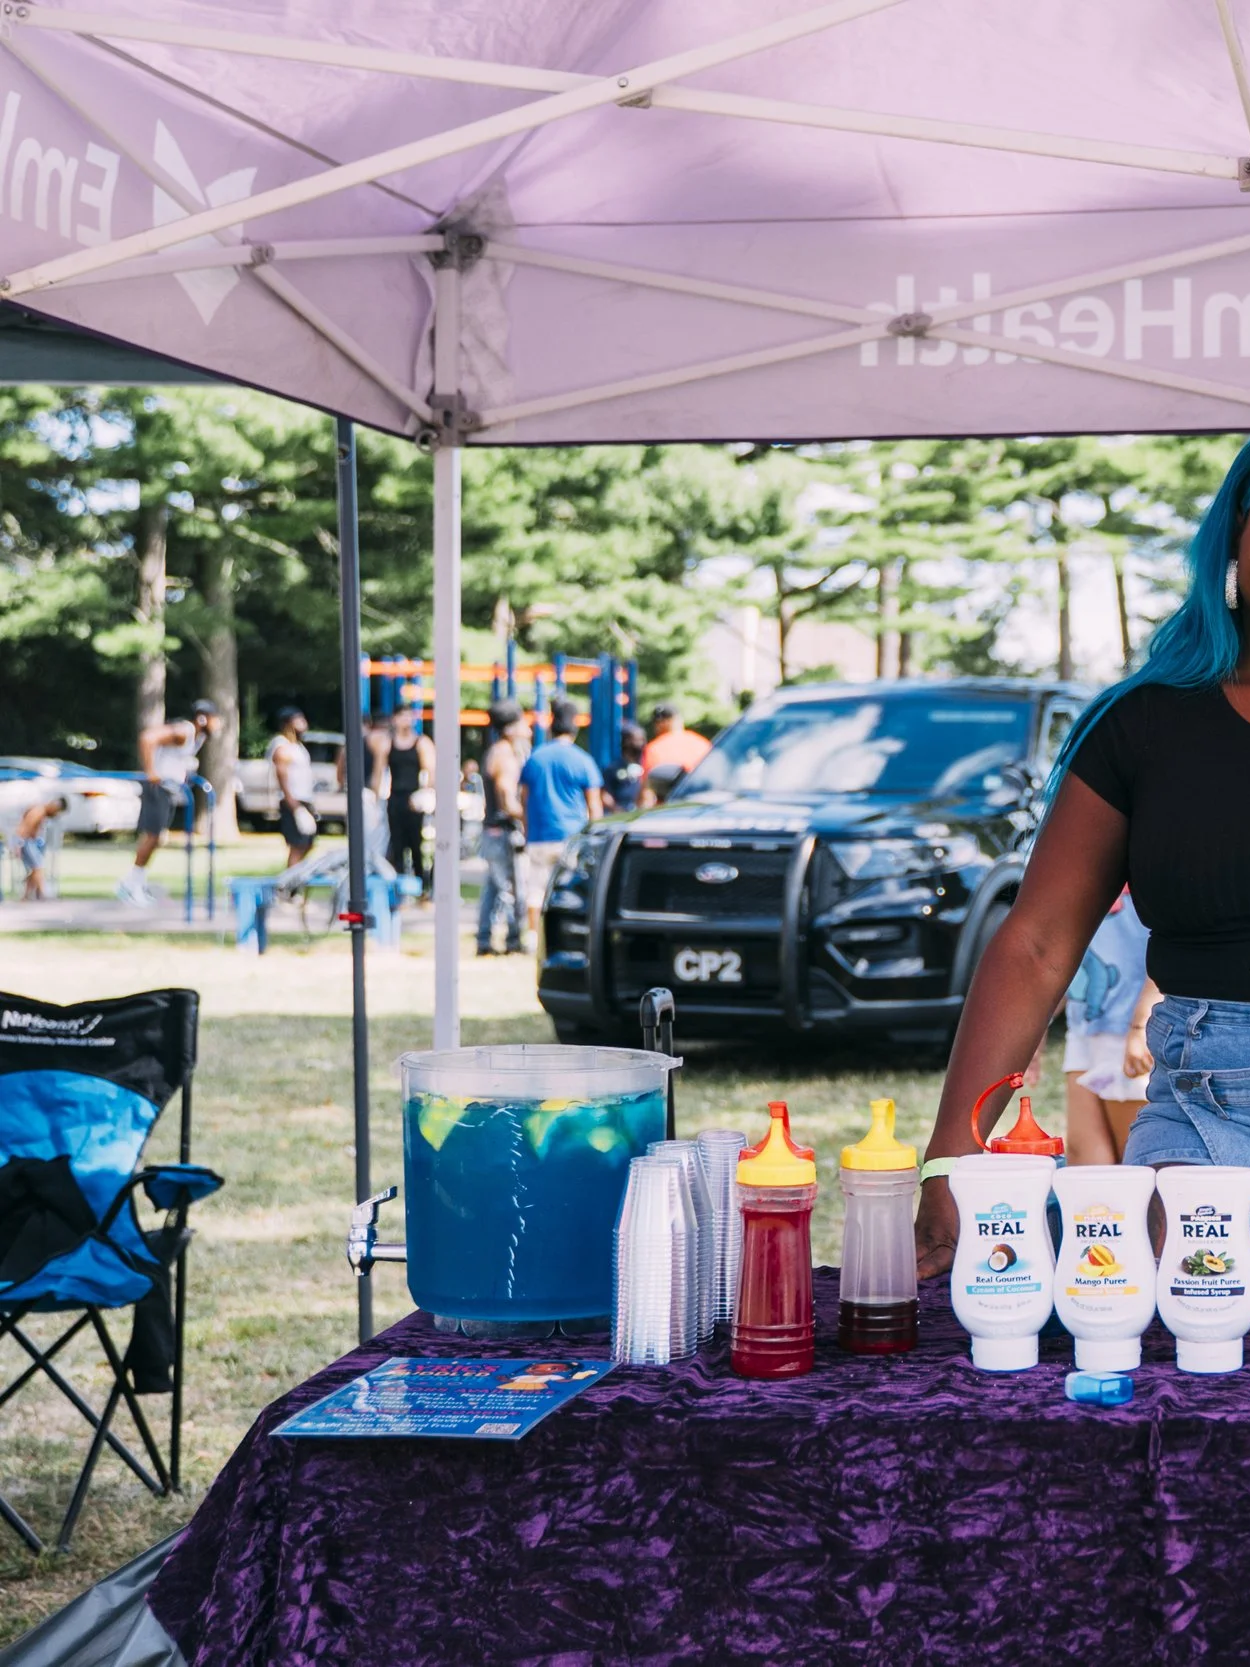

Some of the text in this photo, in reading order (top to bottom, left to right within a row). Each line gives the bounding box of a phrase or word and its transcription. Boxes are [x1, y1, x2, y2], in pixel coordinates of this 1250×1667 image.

[674, 950, 743, 983] CP2
[995, 1275, 1031, 1283] Gourmet
[1075, 1278, 1101, 1286] Mango
[1173, 1277, 1200, 1285] Passion
[1201, 1278, 1218, 1286] Fruit
[1183, 1288, 1231, 1297] Infused Syrup
